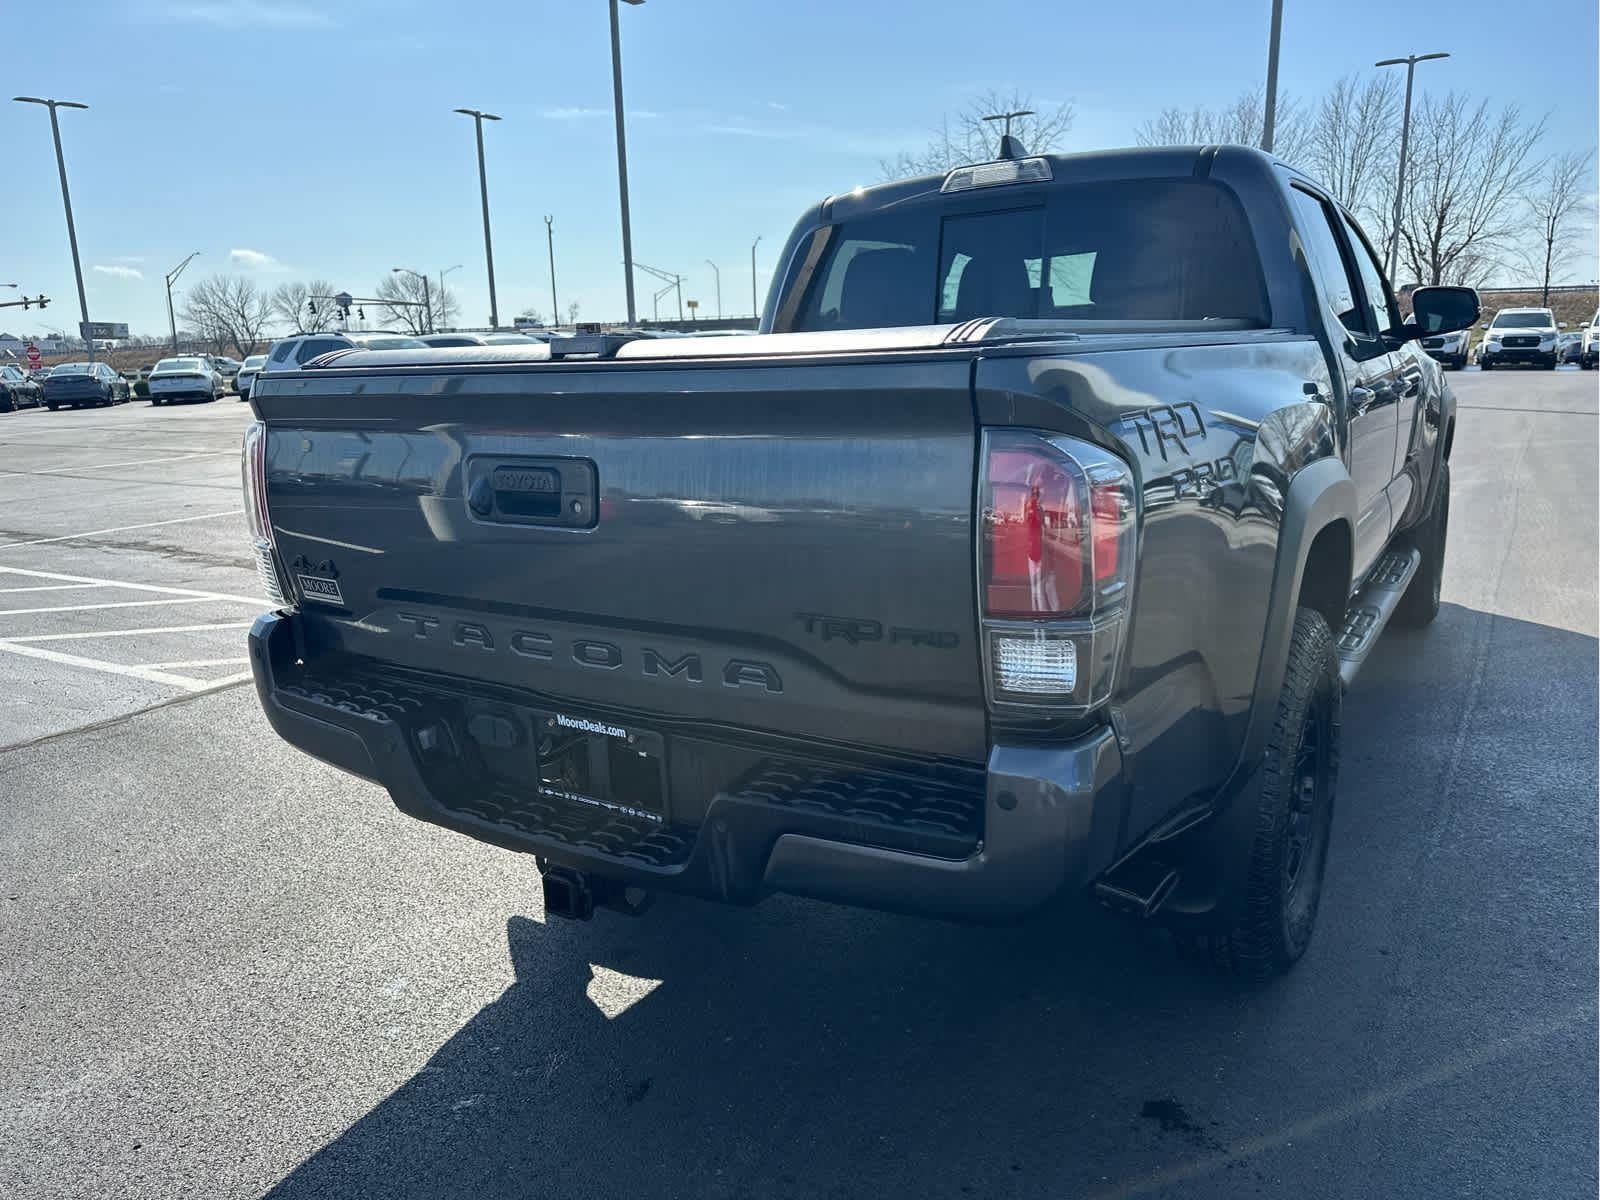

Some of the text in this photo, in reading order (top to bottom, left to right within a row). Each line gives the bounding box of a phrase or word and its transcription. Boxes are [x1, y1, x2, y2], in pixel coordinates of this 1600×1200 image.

[1119, 401, 1207, 462] TRD
[495, 471, 554, 490] TOYOTA
[302, 578, 337, 595] MOORE
[794, 611, 960, 650] TRD PRO
[396, 612, 784, 695] TACOMA
[557, 713, 626, 738] MooreDeals.com
